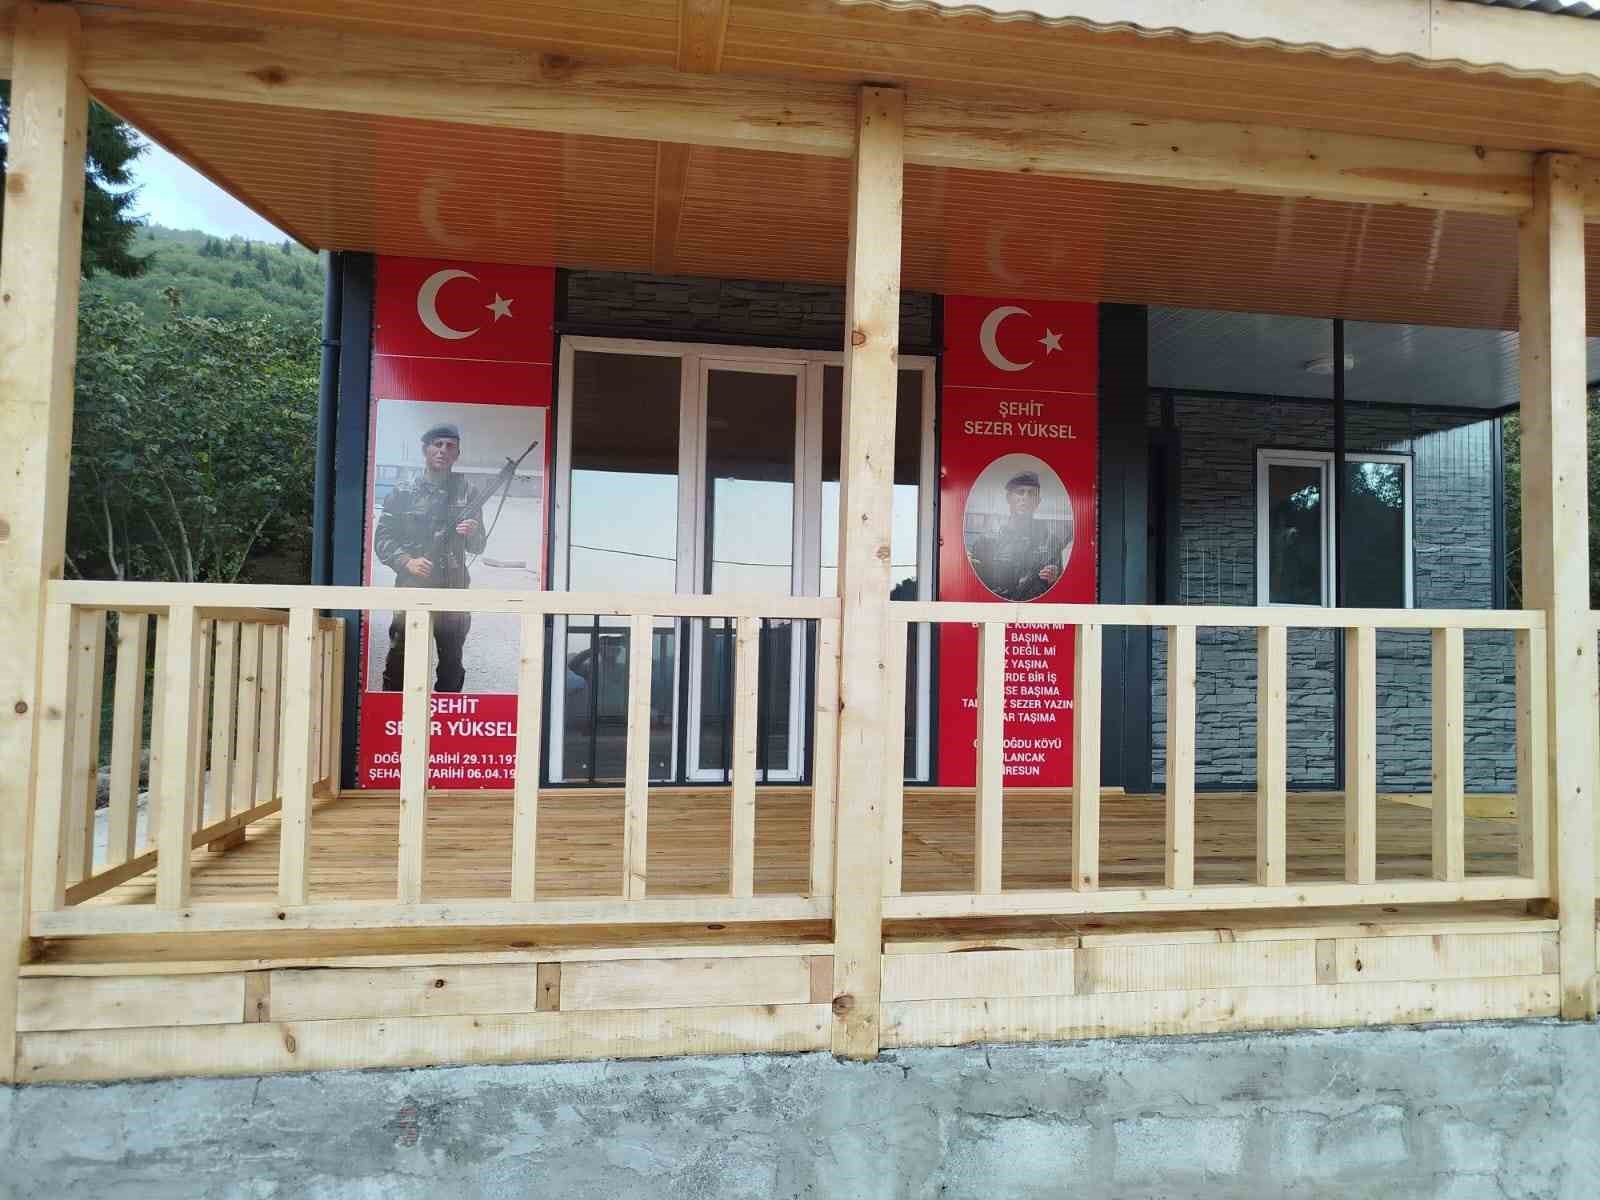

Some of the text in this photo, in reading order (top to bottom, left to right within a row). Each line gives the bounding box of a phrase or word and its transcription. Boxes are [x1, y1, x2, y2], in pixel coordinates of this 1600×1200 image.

[999, 400, 1044, 418] ŞEHİT
[964, 421, 1077, 439] SEZER YÜKSEL
[1011, 633, 1049, 645] BAŞINA
[1012, 645, 1041, 656] DEĞİL
[1011, 659, 1049, 671] YAŞINA
[1028, 671, 1045, 683] BİR
[1021, 685, 1060, 698] BAŞIMA
[430, 695, 479, 717] ŞEHİT
[1010, 699, 1042, 709] SEZER
[1043, 699, 1073, 710] YAZIN
[1018, 712, 1056, 725] TAŞIMA
[385, 718, 518, 737] SER YÜKSEL
[1034, 737, 1062, 749] KÖYÜ
[374, 752, 401, 765] DOĞ
[428, 752, 460, 765] ARİHİ
[1002, 752, 1046, 763] LANCAK
[369, 769, 401, 783] ŞEHA
